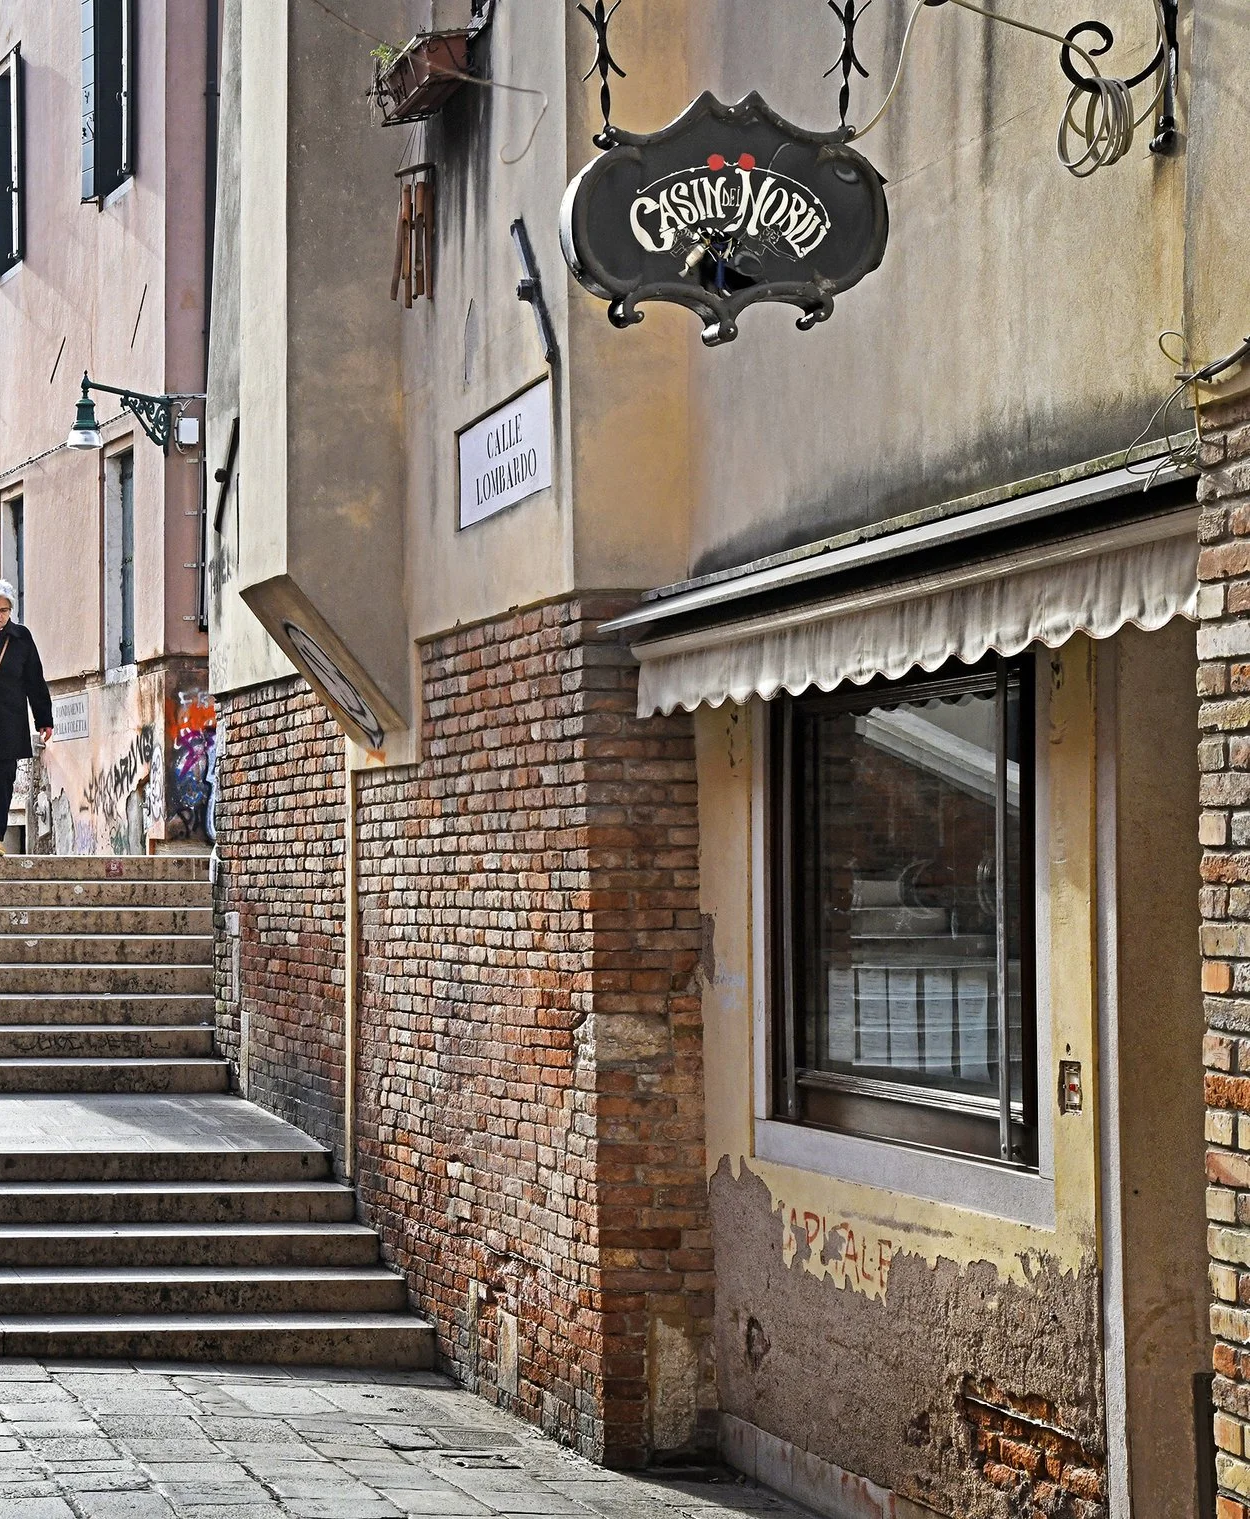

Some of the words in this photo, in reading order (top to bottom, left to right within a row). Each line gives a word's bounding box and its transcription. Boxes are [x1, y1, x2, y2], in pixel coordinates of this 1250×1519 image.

[630, 177, 727, 252] CASIN
[723, 168, 828, 258] NOBILI
[487, 413, 523, 459] CALLE
[476, 448, 537, 505] LOMBARDO
